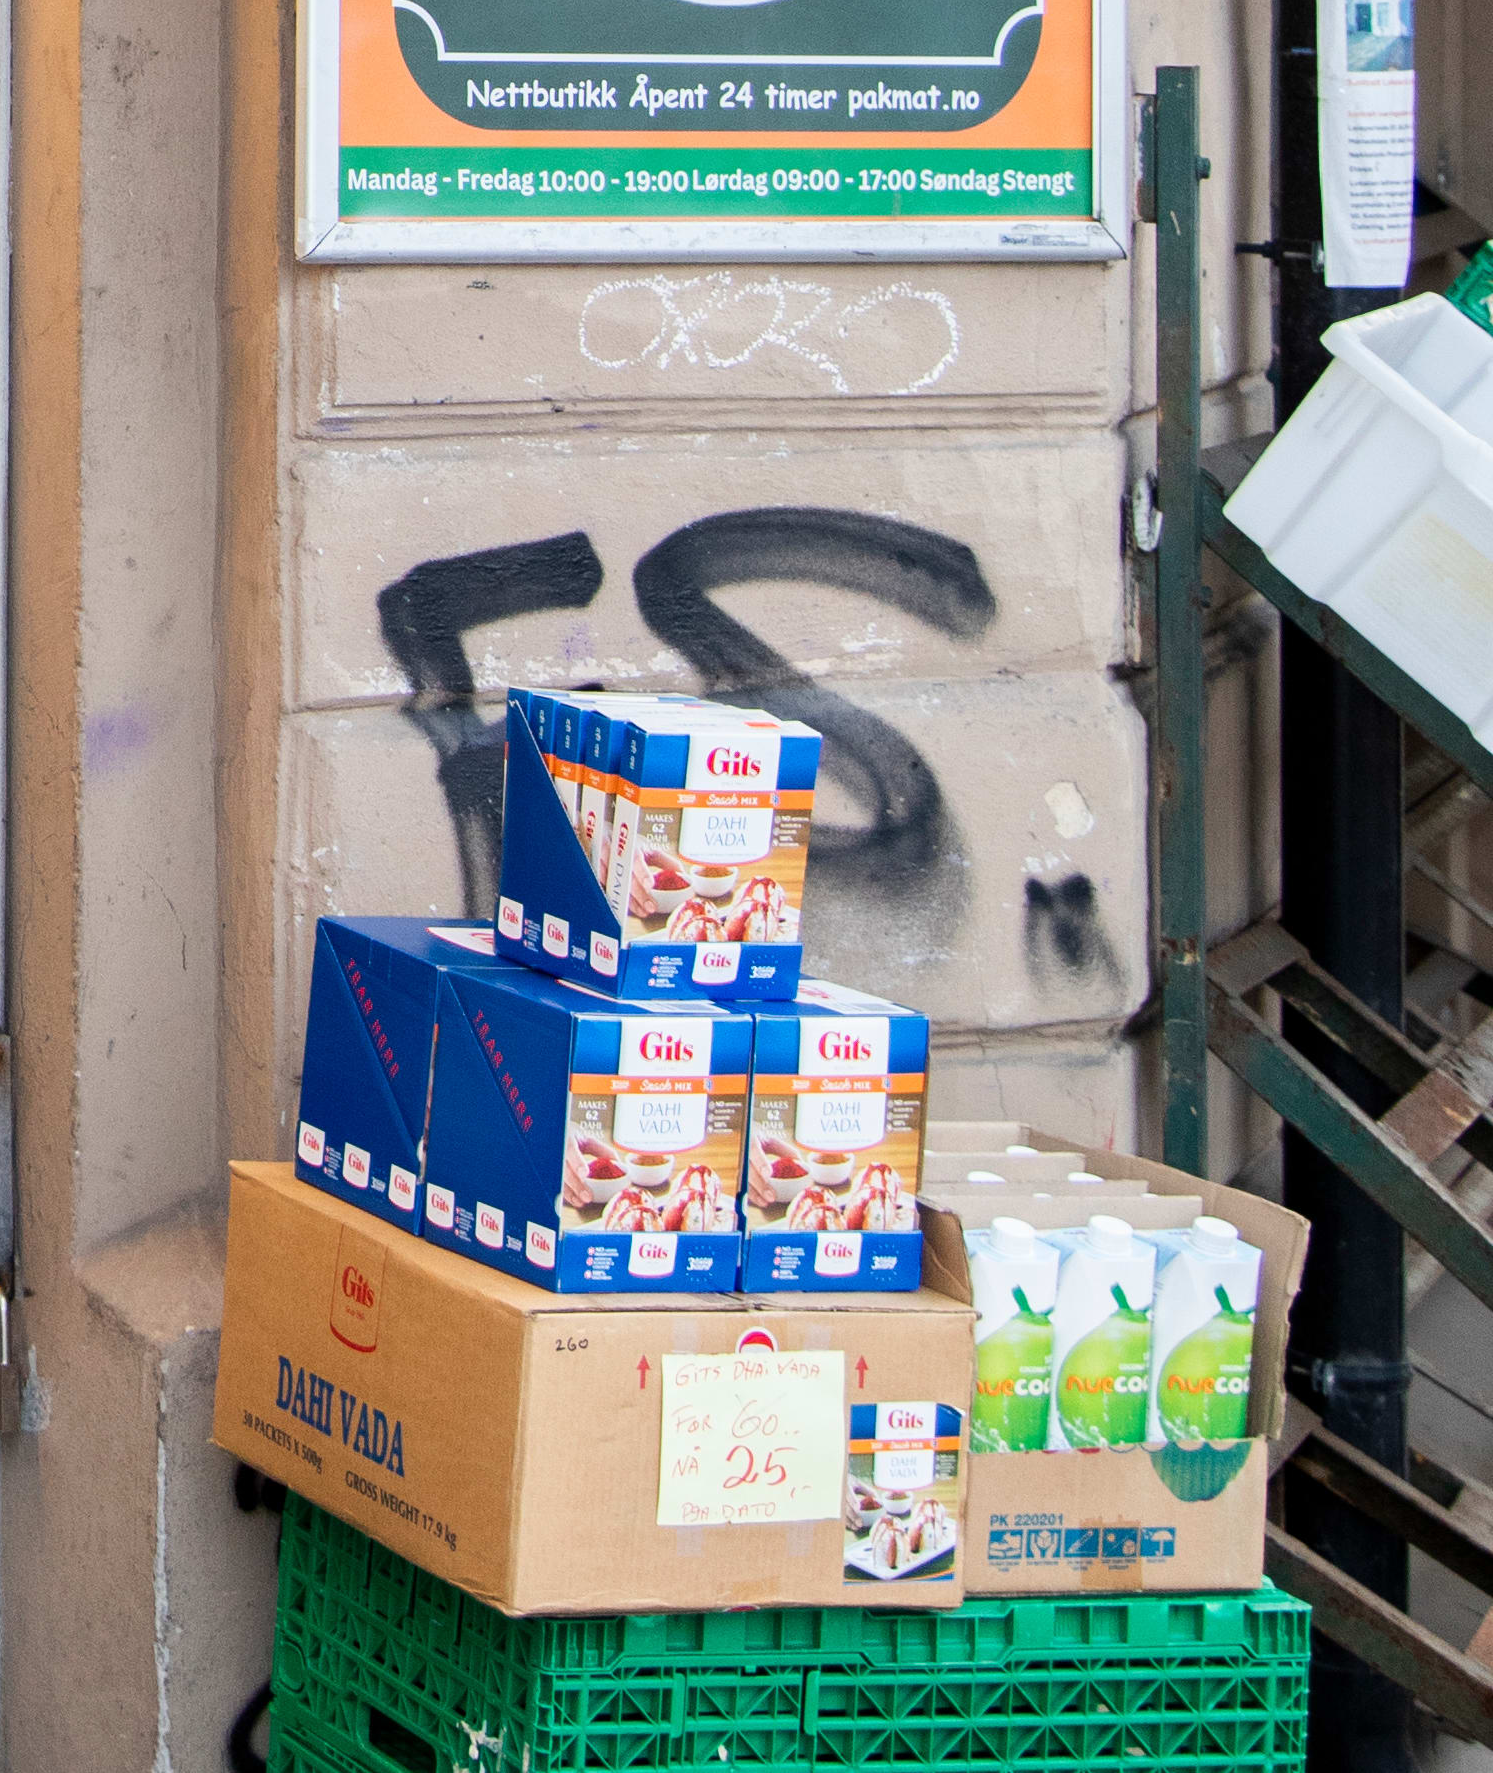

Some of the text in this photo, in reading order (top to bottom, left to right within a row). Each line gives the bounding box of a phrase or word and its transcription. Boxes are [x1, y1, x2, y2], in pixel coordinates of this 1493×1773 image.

[466, 74, 980, 118] Nettbutikk Åpent 24 timer pakmat.no
[348, 167, 1075, 198] Mandag Fredag 10:00 19:00 Lørdag 09:00 17:00 Søndag Stengt
[706, 747, 762, 778] Gits
[741, 795, 759, 806] MIX
[644, 813, 674, 824] MAKES
[707, 815, 747, 831] DAHI
[652, 823, 665, 833] 62
[705, 832, 746, 848] VADA
[594, 941, 615, 962] Gits
[703, 951, 732, 969] Gits
[639, 1031, 694, 1062] Gits
[818, 1031, 872, 1062] Gits
[675, 1082, 692, 1092] MIX
[578, 1100, 608, 1110] MAKES
[641, 1102, 682, 1117] DAHI
[822, 1101, 861, 1116] DAHI
[585, 1110, 599, 1120] 62
[639, 1119, 682, 1135] VADA
[820, 1118, 861, 1134] VADA
[639, 1241, 669, 1260] Gits
[825, 1241, 854, 1259] Gits
[341, 1265, 375, 1309] Gits
[554, 1336, 589, 1353] 260
[276, 1355, 405, 1478] DAHI VADA
[888, 1409, 924, 1431] Gits
[254, 1416, 291, 1454] PACKETS
[891, 1456, 918, 1467] DAHI
[889, 1468, 919, 1479] VADA
[345, 1470, 457, 1552] GROSS WEIGHT 17.9 kg
[990, 1513, 1063, 1526] PK 220201
